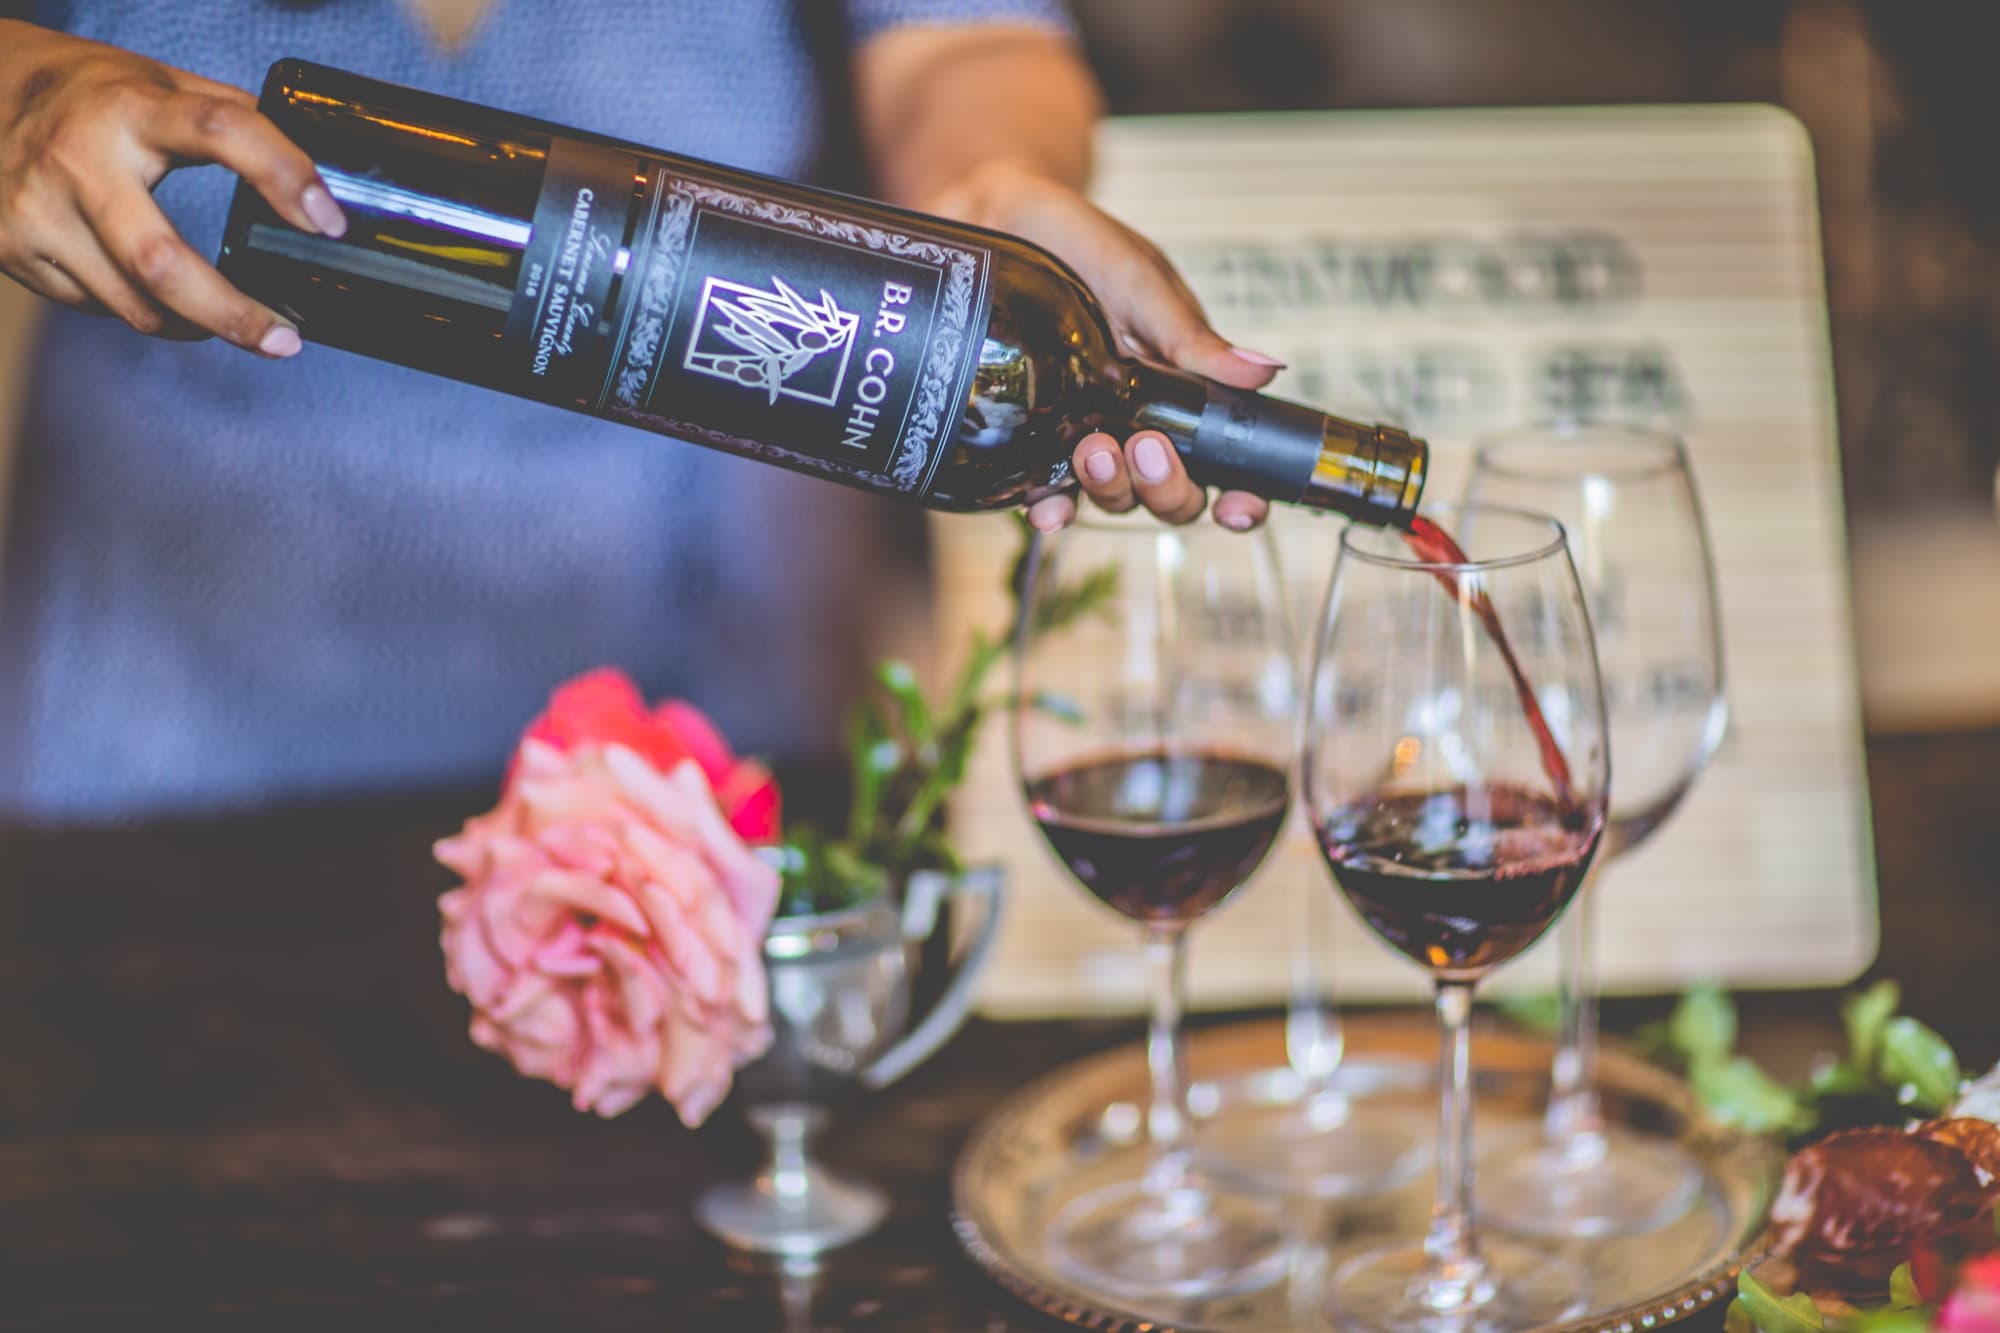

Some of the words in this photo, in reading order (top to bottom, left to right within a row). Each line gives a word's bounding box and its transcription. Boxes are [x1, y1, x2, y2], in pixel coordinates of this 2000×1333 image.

[558, 187, 594, 280] CABERNET
[532, 283, 569, 376] SAUVIGNON
[873, 280, 913, 338] B.R.
[841, 347, 895, 450] COHN
